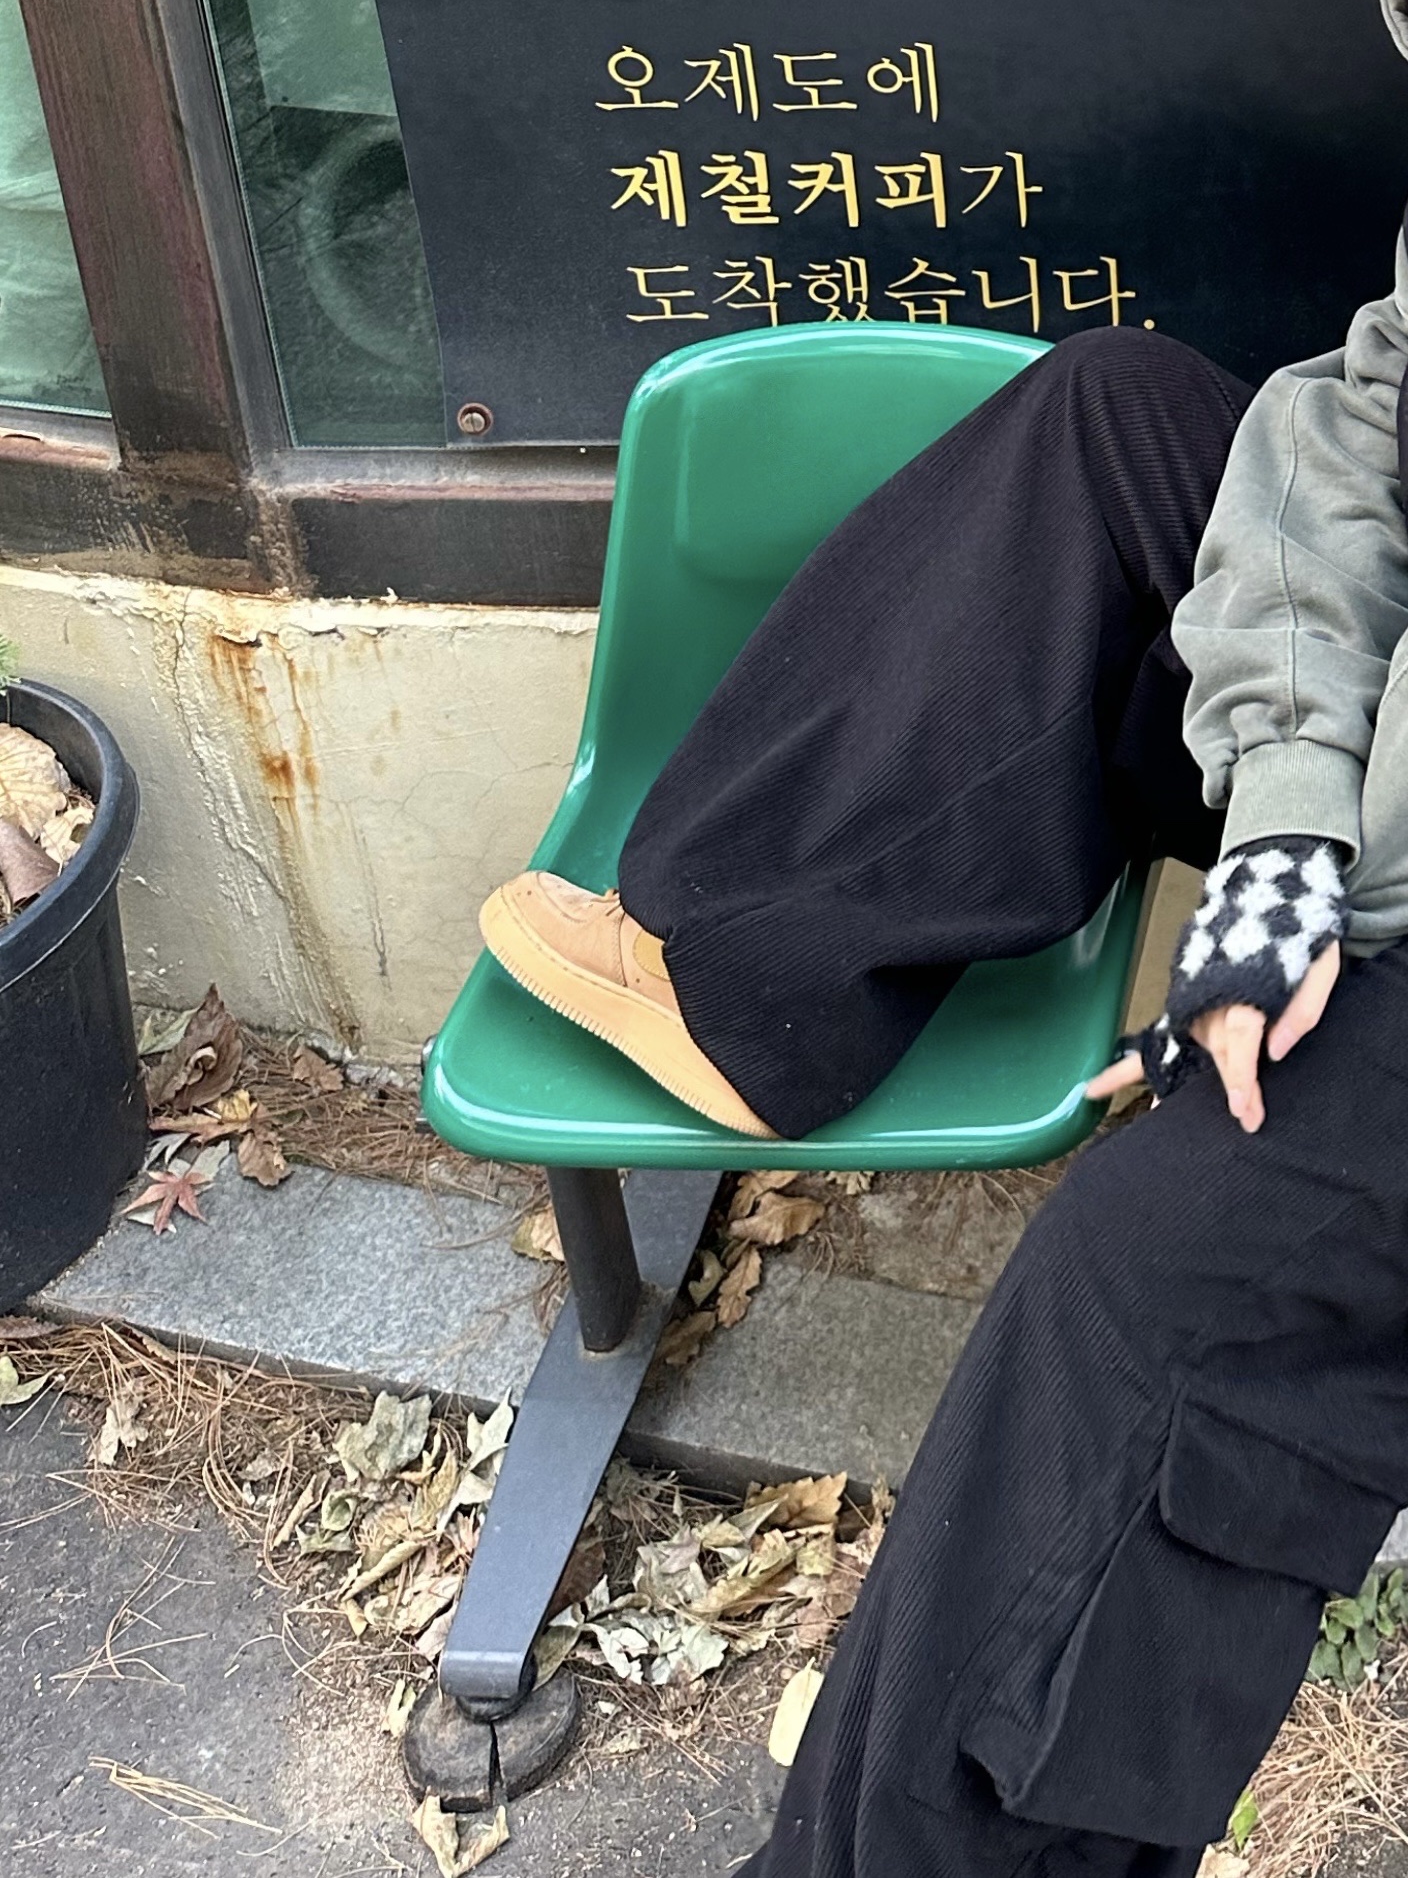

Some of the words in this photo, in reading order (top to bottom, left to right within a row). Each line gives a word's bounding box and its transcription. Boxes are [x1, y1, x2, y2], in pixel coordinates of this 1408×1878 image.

[595, 42, 939, 122] 오제도에
[610, 149, 1043, 228] 제철커피가
[625, 256, 1156, 334] 도착했습니다.
